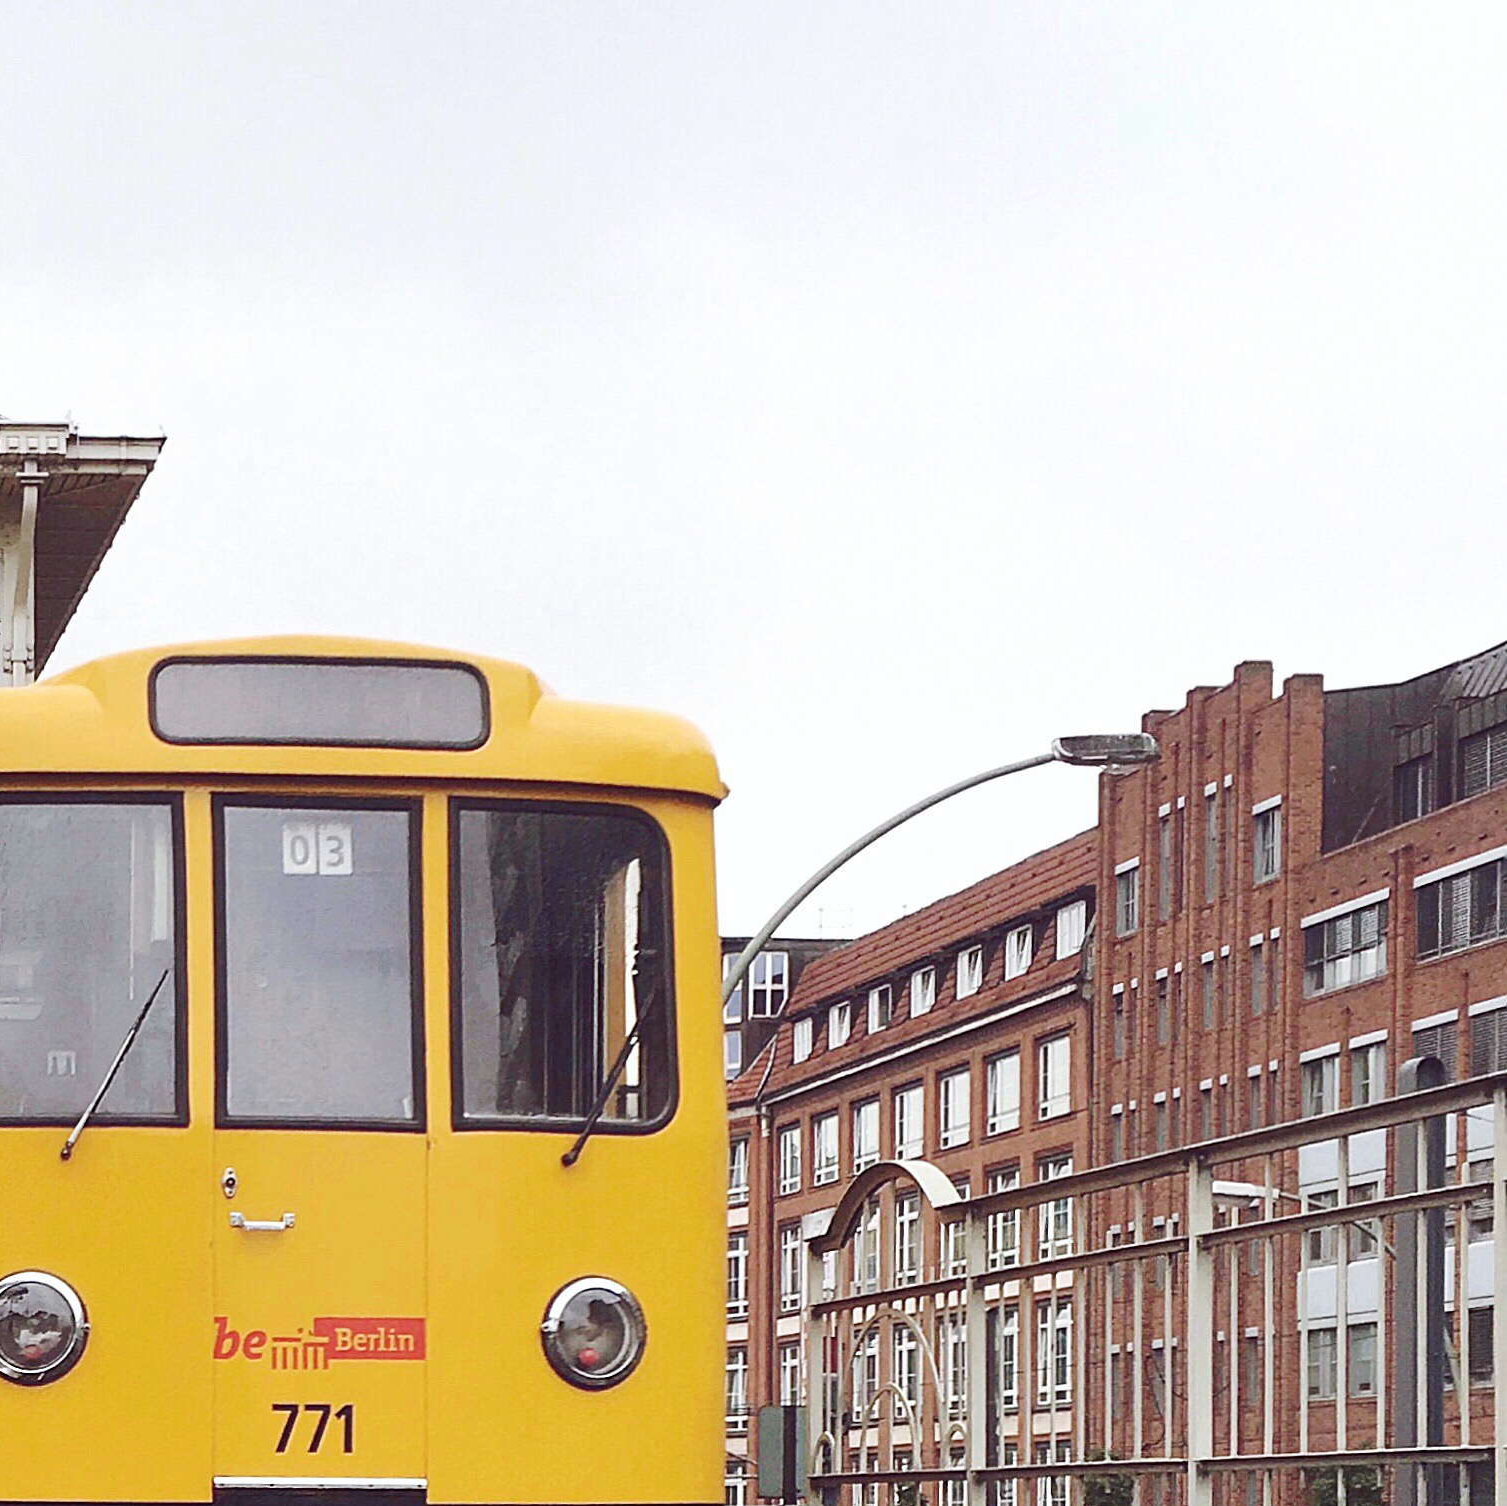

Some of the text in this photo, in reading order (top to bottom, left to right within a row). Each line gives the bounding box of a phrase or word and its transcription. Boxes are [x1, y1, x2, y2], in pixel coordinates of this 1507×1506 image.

[291, 835, 345, 867] 03
[213, 1316, 415, 1360] be Berlin
[271, 1403, 354, 1454] 771
